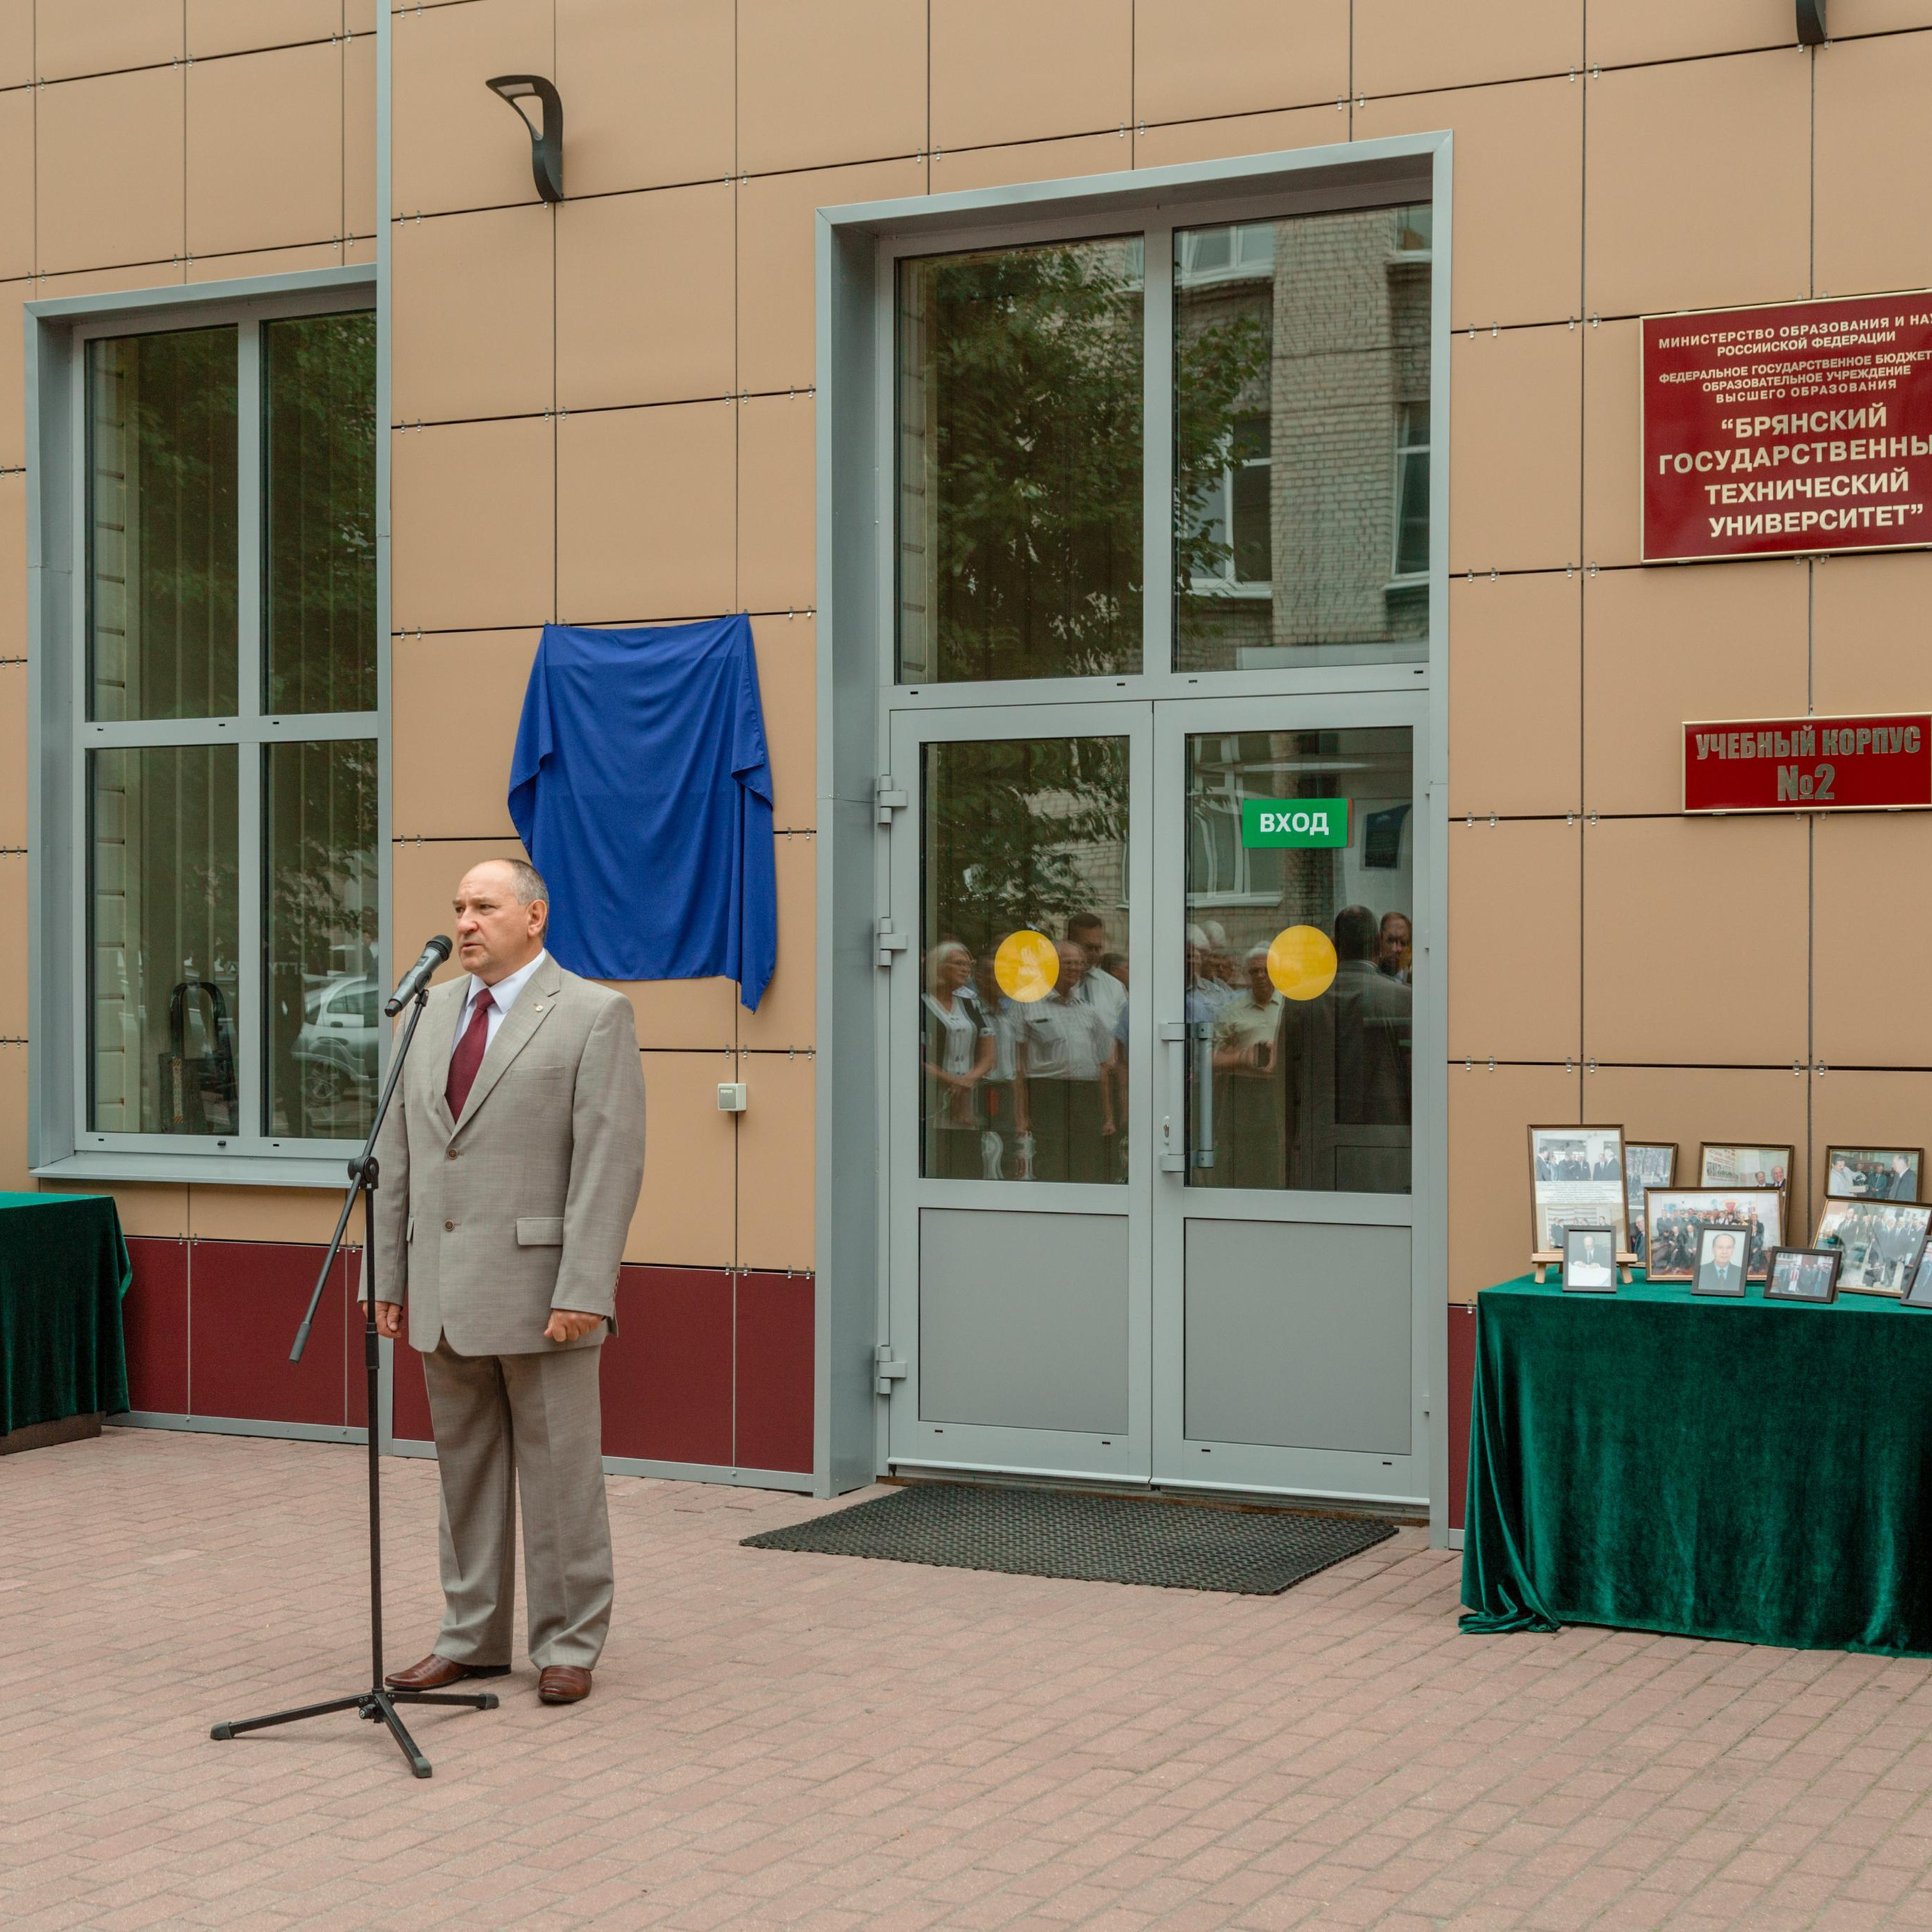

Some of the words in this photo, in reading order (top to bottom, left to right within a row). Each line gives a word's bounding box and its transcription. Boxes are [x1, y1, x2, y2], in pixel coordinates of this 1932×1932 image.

[1658, 328, 1774, 349] МИНИСТЕРСТВО
[1779, 317, 1890, 338] ОБРАЗОВАНИЯ
[1894, 315, 1905, 327] И
[1811, 331, 1897, 348] ФЕДЕРАЦИИ
[1659, 366, 1749, 383] ФЕДЕРАЛЬНОЕ
[1752, 355, 1872, 374] ГОСУДАРСТВЕННОЕ
[1875, 350, 1932, 364] БЮДЖЕТ
[1702, 372, 1823, 392] ОБРАЗОВАТЕЛЬНОЕ
[1826, 365, 1912, 381] УЧРЕЖДЕНИЕ
[1715, 388, 1786, 404] ВЫСШЕГО
[1790, 379, 1897, 397] ОБРАЗОВАНИЯ
[1721, 401, 1887, 438] “БРЯНСКИЙ
[1704, 466, 1909, 505] ТЕХНИЧЕСКИЙ
[1709, 503, 1924, 537] УНИВЕРСИТЕТ”
[1695, 725, 1816, 760] УЧЕБНЫЙ
[1822, 726, 1921, 756] КОРПУС
[1777, 763, 1836, 801] №2
[1260, 812, 1330, 836] ВХОД
